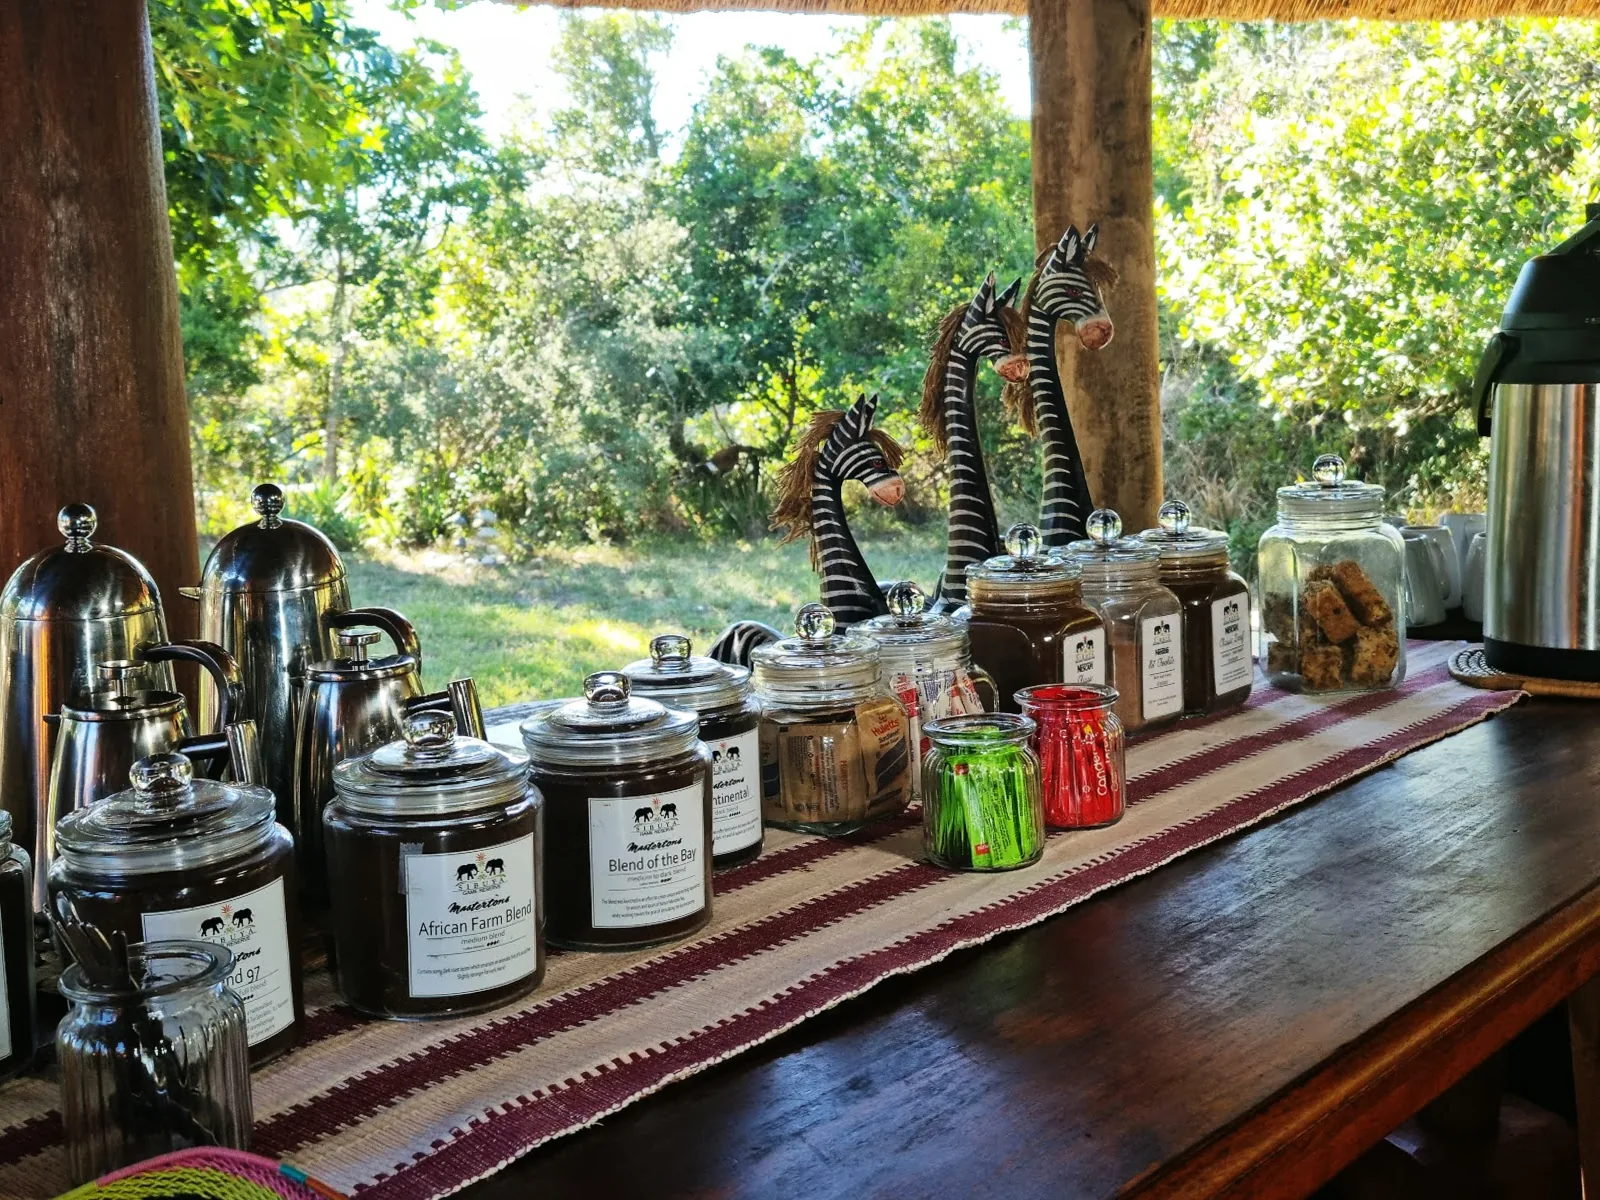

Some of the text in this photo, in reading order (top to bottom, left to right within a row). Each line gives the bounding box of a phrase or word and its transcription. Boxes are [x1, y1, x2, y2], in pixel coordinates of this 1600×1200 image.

[713, 785, 749, 805] ntinental
[636, 821, 677, 832] SIBUYA
[626, 838, 683, 853] Mastertons
[609, 848, 697, 872] Blend of the Bay
[447, 896, 511, 914] Mastertons
[418, 899, 532, 936] African Farm Blend
[212, 928, 256, 943] IBUYA
[461, 930, 506, 945] medium blend
[246, 966, 260, 984] 97
